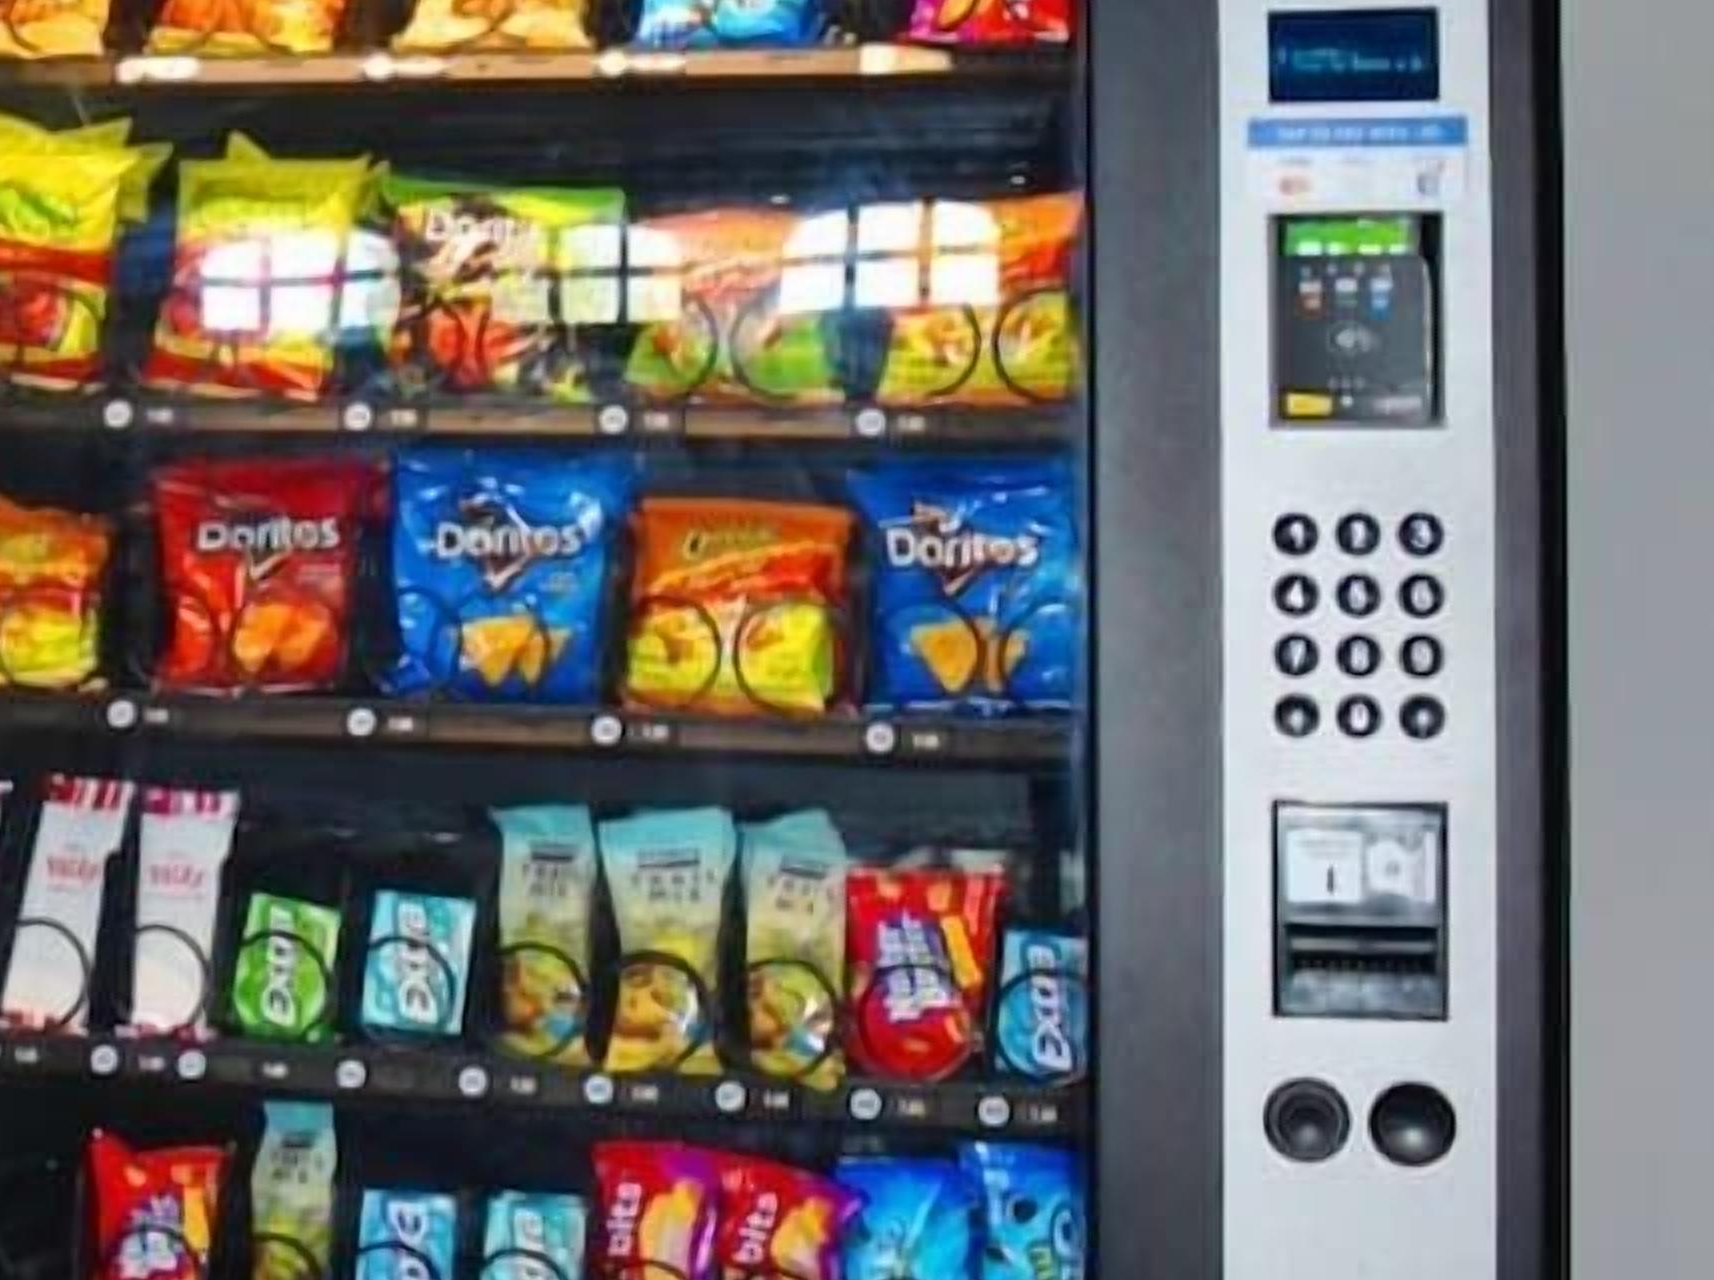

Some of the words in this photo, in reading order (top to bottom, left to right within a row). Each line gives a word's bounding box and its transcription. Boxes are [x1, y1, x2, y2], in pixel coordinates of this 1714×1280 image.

[198, 518, 342, 552] Doritos
[437, 521, 583, 559] Doritos
[886, 527, 1040, 568] Doritos
